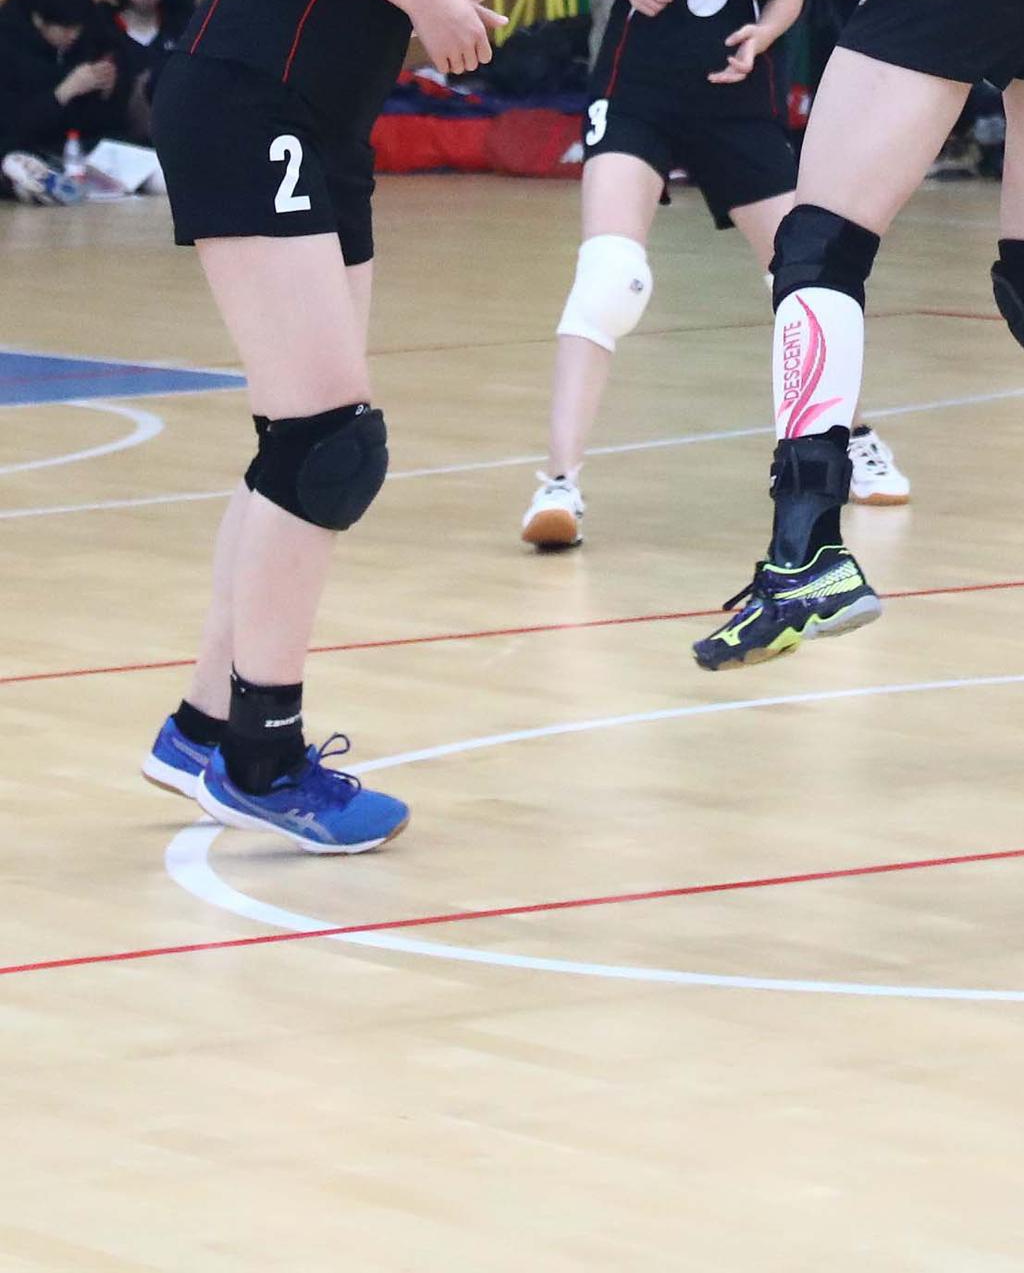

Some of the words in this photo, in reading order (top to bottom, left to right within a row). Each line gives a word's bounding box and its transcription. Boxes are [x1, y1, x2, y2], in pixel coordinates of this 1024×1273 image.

[585, 98, 609, 146] 3
[269, 134, 312, 214] 2
[783, 320, 803, 402] DESCENTE
